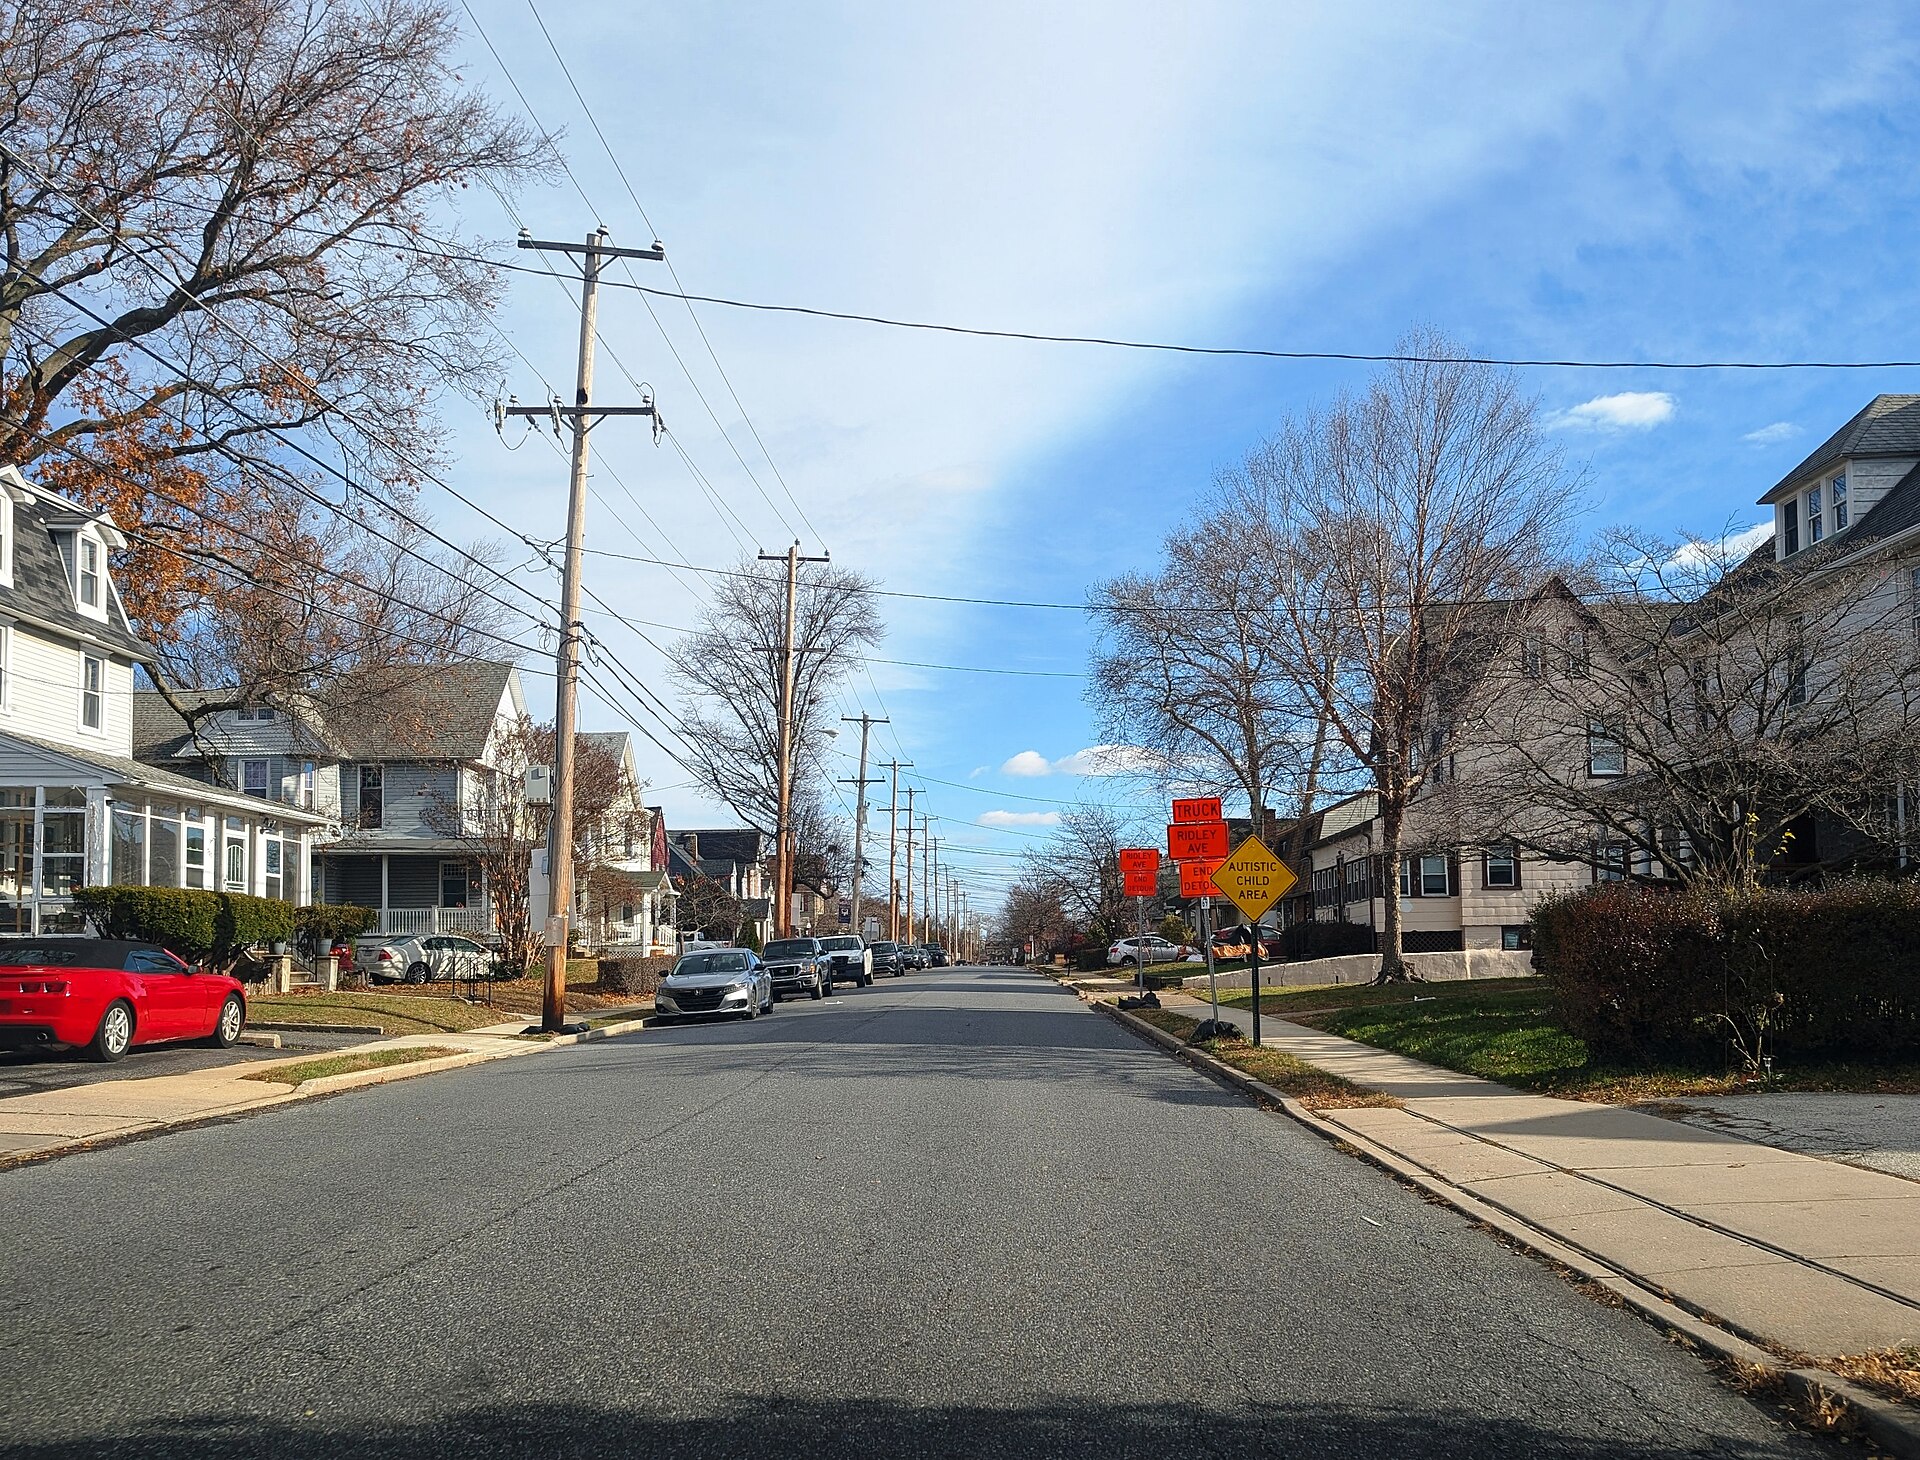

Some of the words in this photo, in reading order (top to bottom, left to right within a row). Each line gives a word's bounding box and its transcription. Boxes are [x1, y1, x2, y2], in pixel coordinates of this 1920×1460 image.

[1176, 802, 1219, 818] TRUCK
[1177, 830, 1217, 841] RIDLEY
[1187, 843, 1209, 854] AVE
[1126, 852, 1153, 860] RIDLEY
[1193, 866, 1213, 876] END
[1228, 862, 1277, 872] AUTISTIC
[1184, 881, 1217, 891] DETOU
[1236, 876, 1270, 886] CHILD
[1238, 890, 1269, 900] AREA
